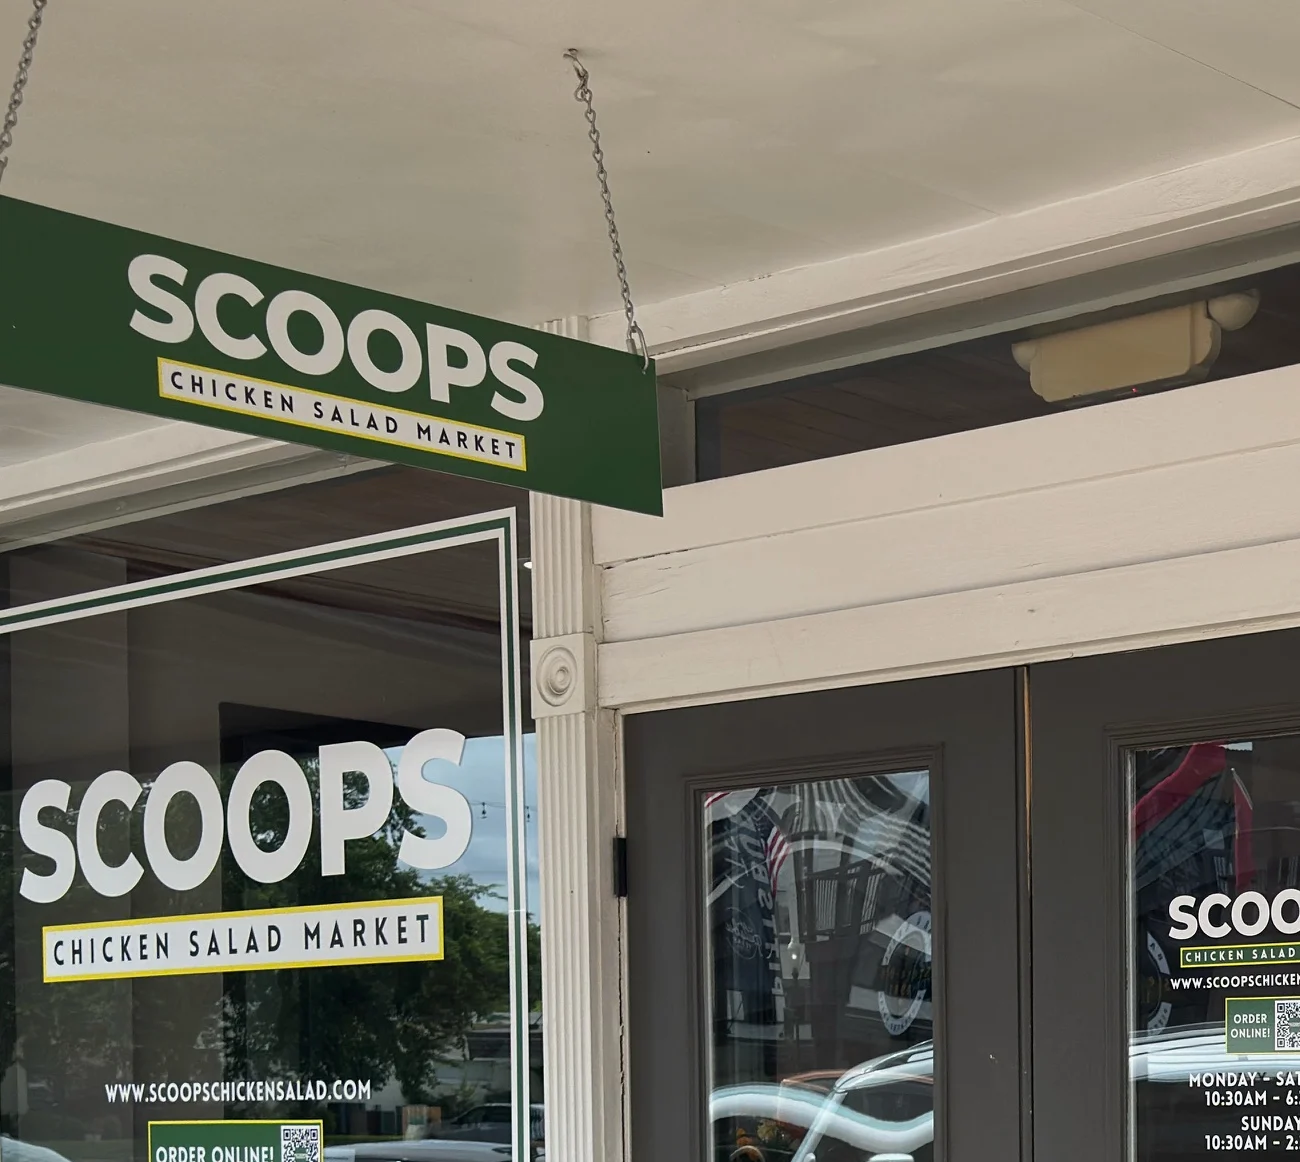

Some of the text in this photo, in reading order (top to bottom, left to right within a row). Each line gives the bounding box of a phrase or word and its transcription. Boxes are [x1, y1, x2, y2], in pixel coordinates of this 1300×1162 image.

[127, 253, 545, 422] SCOOPS
[170, 370, 516, 459] CHICKEN SALAD MARKET
[18, 727, 473, 904] SCOOPS
[53, 913, 430, 966] CHICKEN SALAD MARKET
[1185, 949, 1244, 963] CHICKEN
[1252, 947, 1296, 960] SALAD
[1233, 1013, 1267, 1024] ORDER
[1230, 1027, 1270, 1039] ONLINE!
[1188, 1072, 1258, 1088] MONDAY
[105, 1078, 371, 1104] WWW.SCOOPSCHICKENSALAD.COM
[1204, 1090, 1267, 1106] 10:30AM
[1204, 1134, 1267, 1151] 10:30AM
